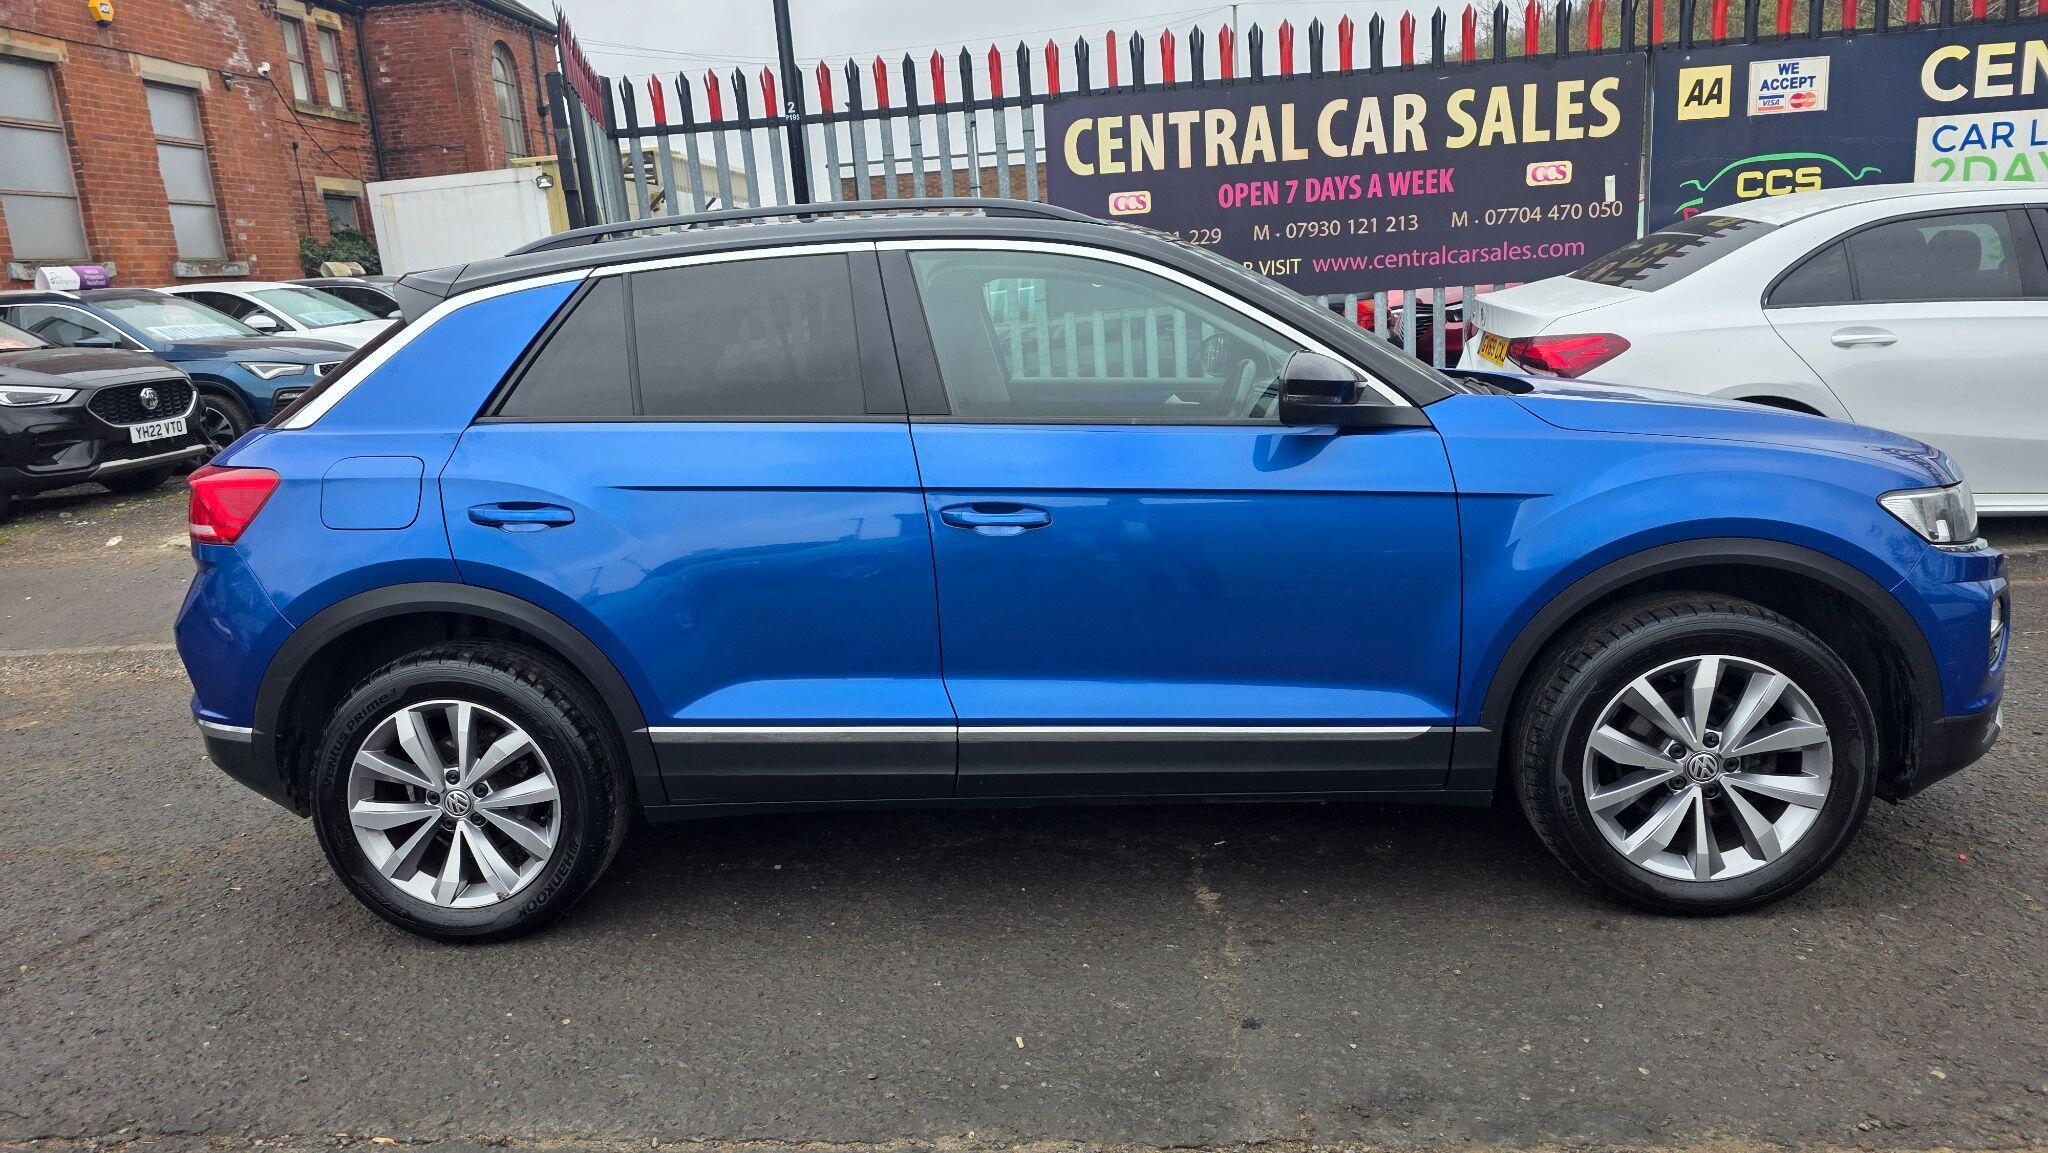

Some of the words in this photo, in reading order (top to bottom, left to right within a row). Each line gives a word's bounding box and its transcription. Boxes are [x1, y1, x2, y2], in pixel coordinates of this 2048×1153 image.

[1778, 62, 1799, 75] WE
[1684, 77, 1723, 107] AA
[1760, 76, 1816, 91] ACCEPT
[787, 101, 795, 113] 2
[1063, 103, 1309, 176] CENTRAL
[1317, 93, 1429, 159] CAR
[1445, 76, 1621, 149] SALES
[1932, 122, 2014, 152] CAR
[1218, 180, 1279, 208] OPEN
[1285, 180, 1299, 204] 7
[1305, 174, 1362, 203] DAYS
[1367, 172, 1383, 199] A
[1388, 168, 1455, 196] WEEK
[1736, 166, 1822, 198] CCS
[1485, 206, 1542, 226] 07704
[1548, 203, 1582, 220] 470
[1588, 201, 1622, 218] 050
[1189, 228, 1222, 245] 229
[1286, 222, 1341, 240] 07930
[1348, 218, 1378, 235] 121
[1386, 214, 1419, 232] 213
[1259, 259, 1302, 276] VISIT
[1312, 239, 1586, 273] www.centralcarsales.com
[136, 424, 162, 440] YH22
[164, 421, 182, 435] VTO
